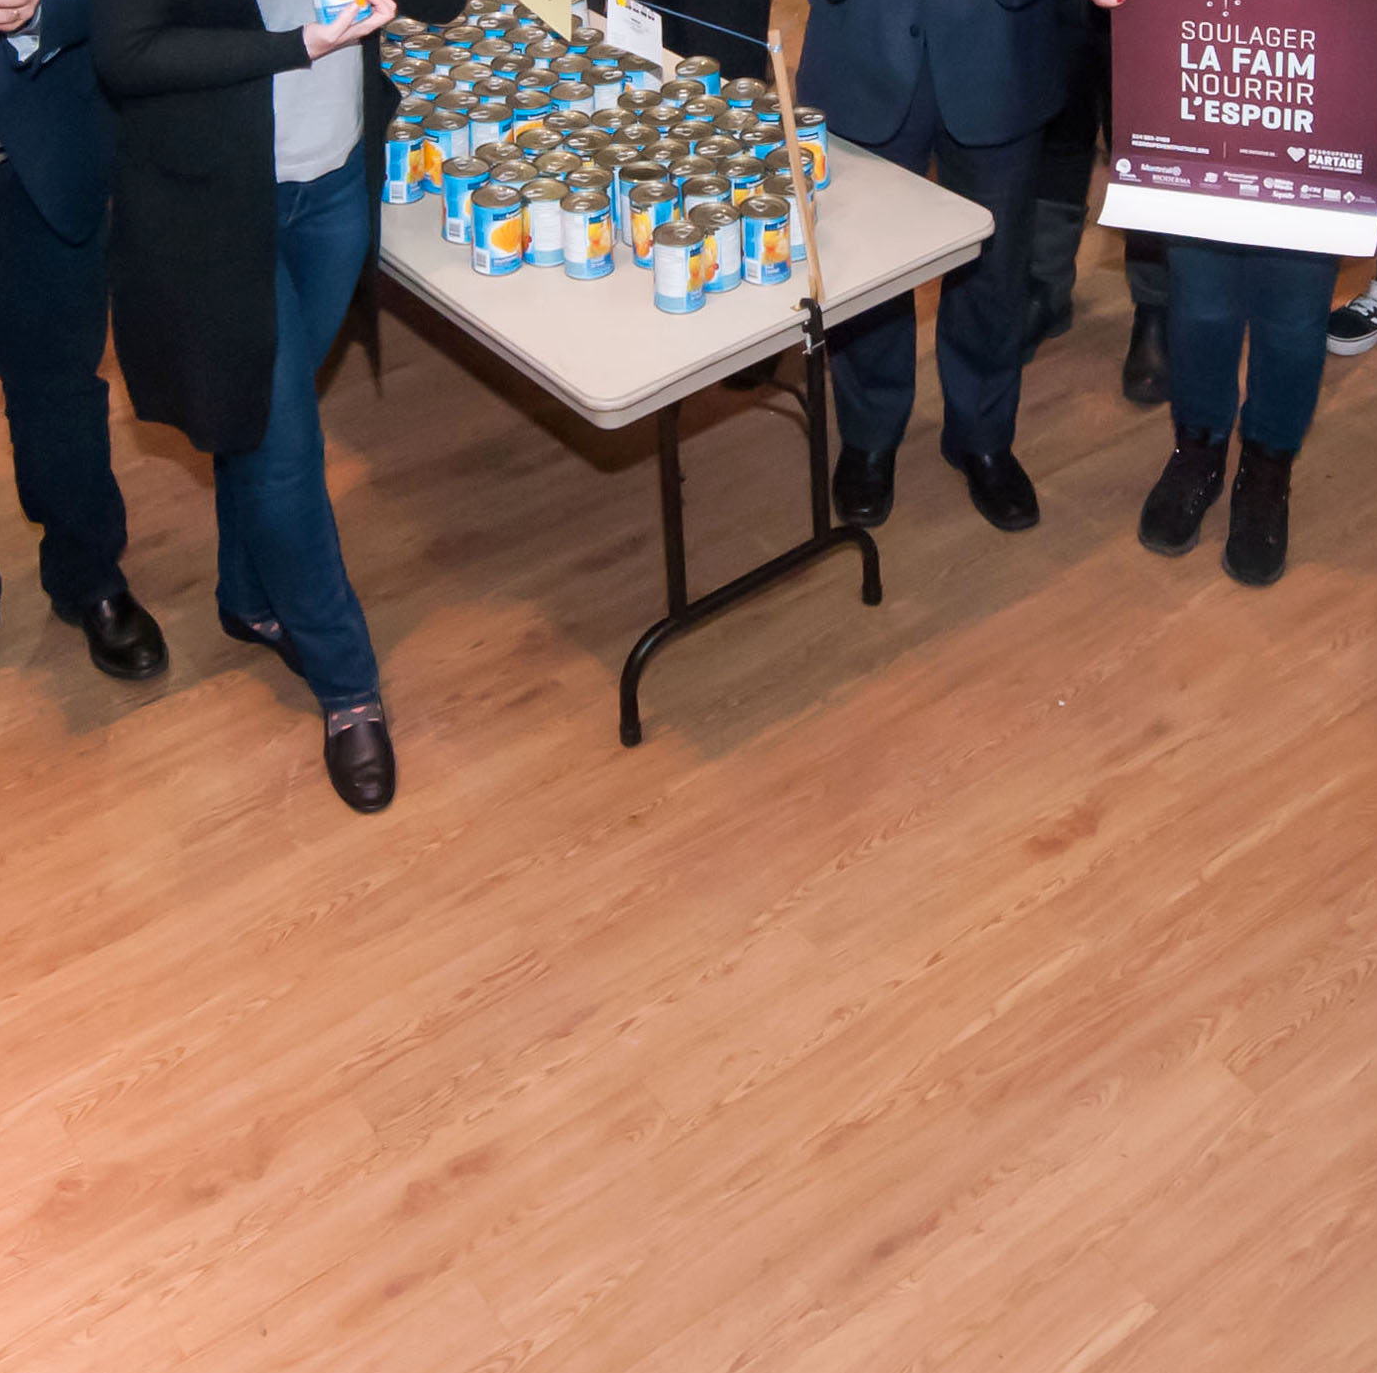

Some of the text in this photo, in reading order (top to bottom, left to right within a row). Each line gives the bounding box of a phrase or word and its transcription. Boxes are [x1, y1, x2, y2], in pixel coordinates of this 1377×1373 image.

[1181, 20, 1316, 51] SOULAGER
[1180, 43, 1315, 81] LA FAIM
[1181, 71, 1314, 106] NOURRIR
[1180, 97, 1314, 134] L'ESPOIR
[1308, 153, 1363, 171] PARTAGE
